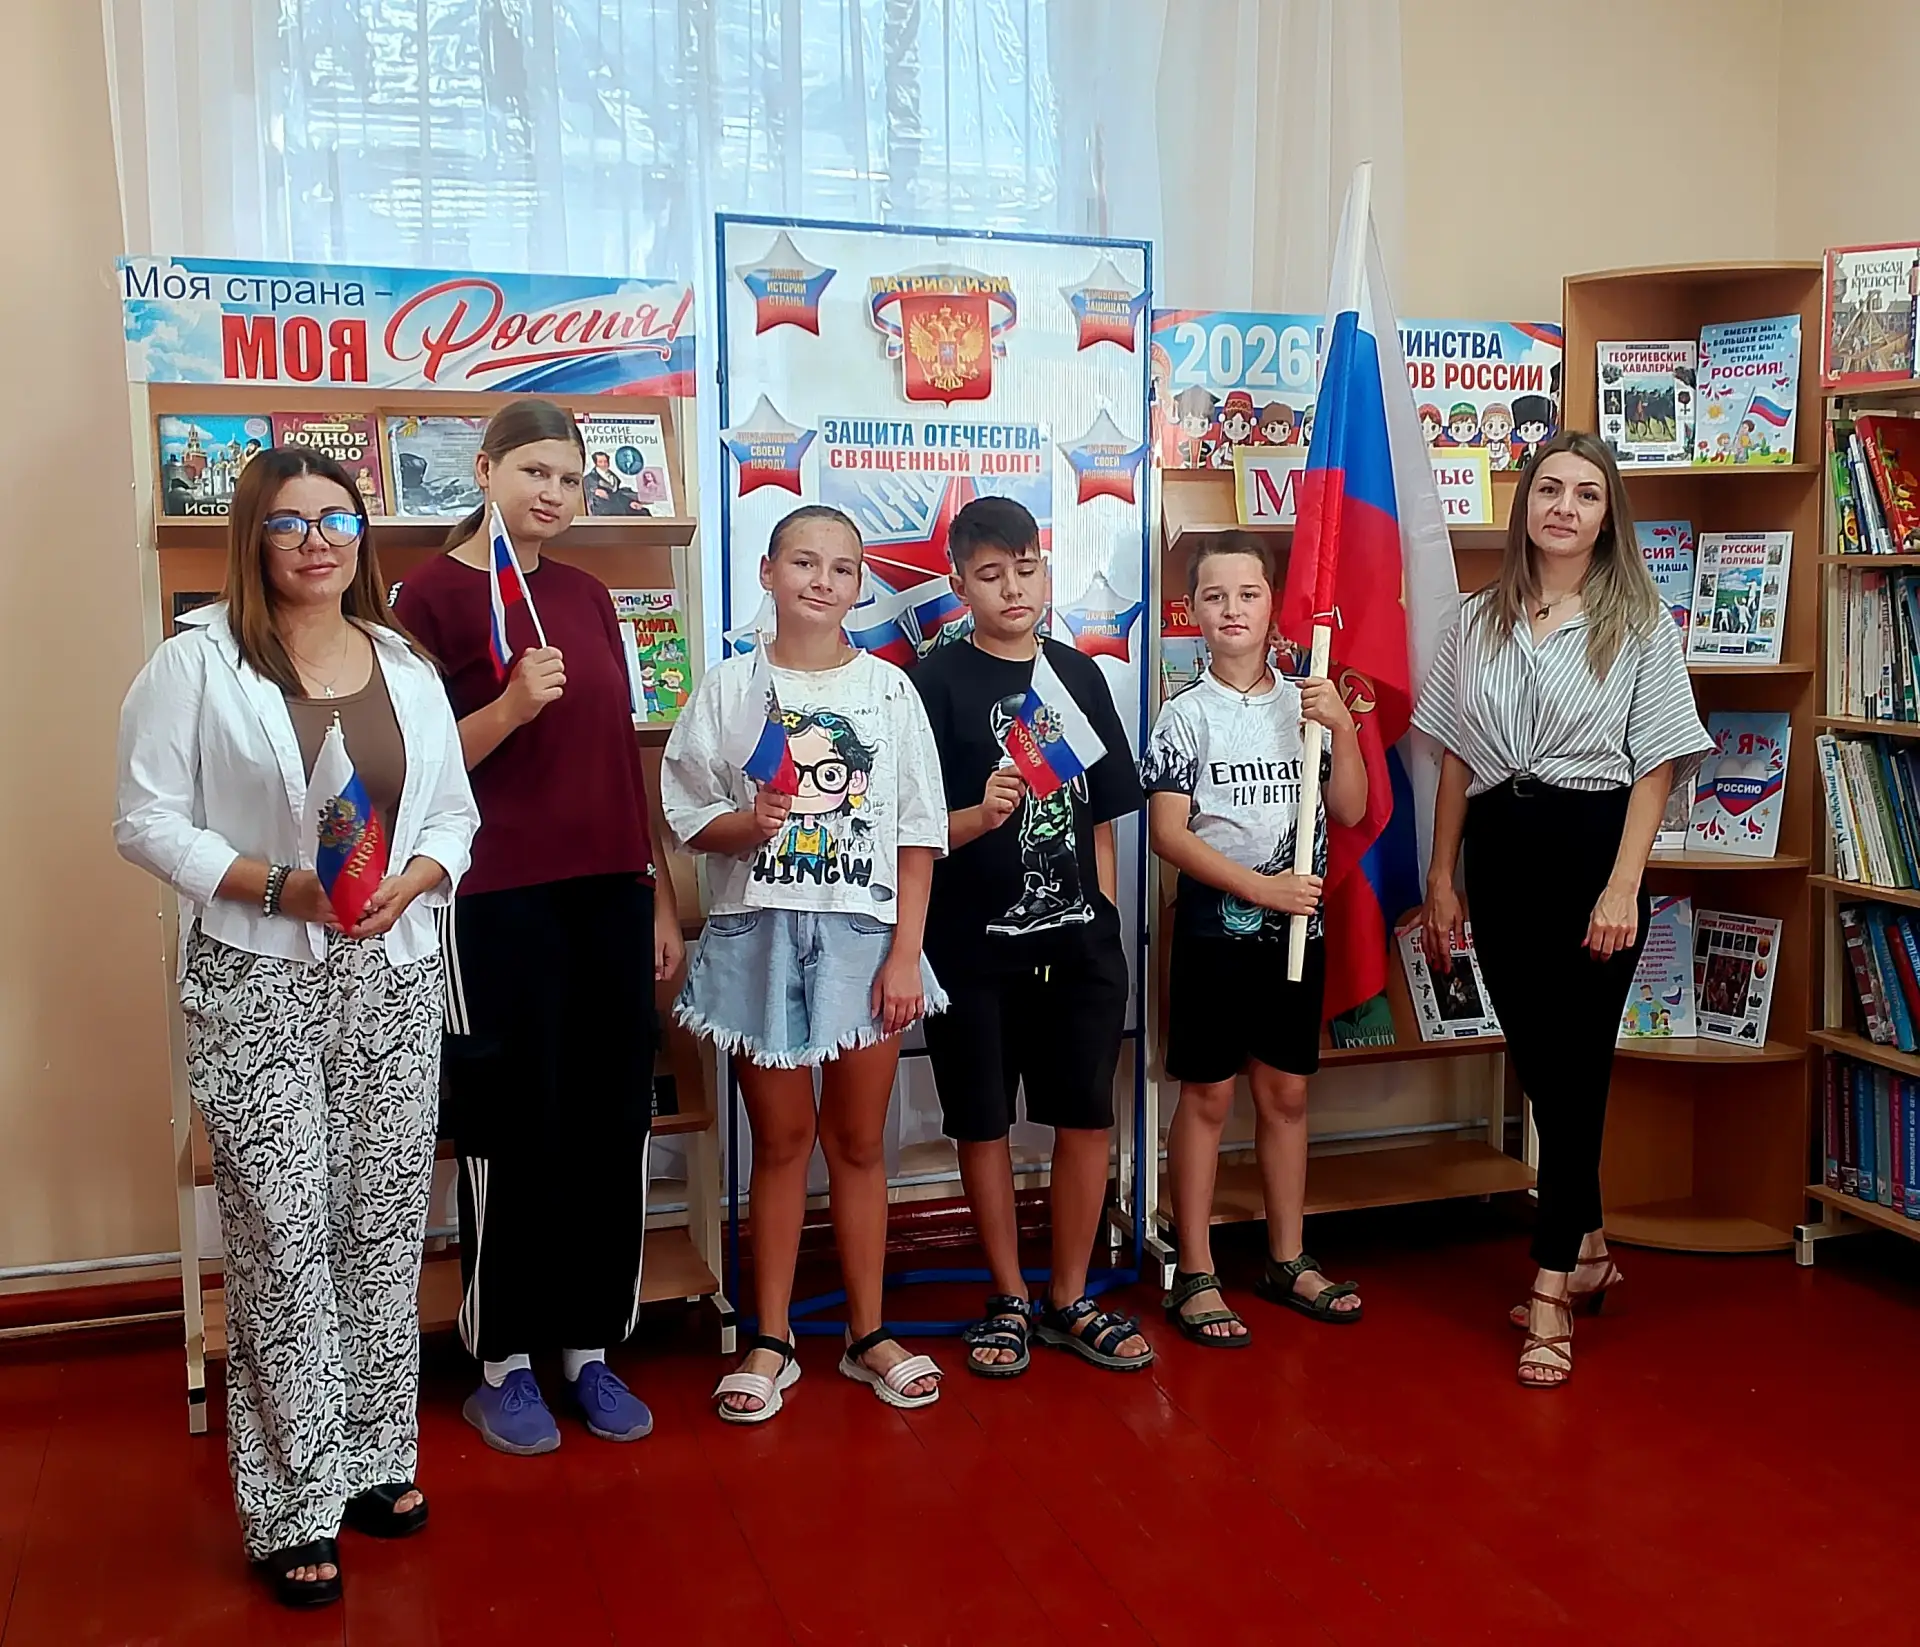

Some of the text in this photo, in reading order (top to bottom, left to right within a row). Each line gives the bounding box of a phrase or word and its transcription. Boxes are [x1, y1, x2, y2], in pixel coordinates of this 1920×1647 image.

[1854, 260, 1903, 278] РУССКАЯ
[125, 265, 210, 300] Моя
[226, 277, 365, 311] страна
[767, 281, 807, 294] ИСТОРИИ
[870, 276, 1011, 293] ПАТРИОТИЗМ
[1851, 275, 1906, 295] КРЕПОСТЬ
[769, 295, 805, 307] СТРАНЫ
[221, 278, 693, 384] МОЯ Россия!
[1174, 322, 1311, 387] 2026
[1398, 330, 1503, 359] ИНСТВА
[1609, 352, 1687, 363] ГЕОРГИЕВСКИЕ
[1730, 354, 1764, 363] СТРАНА
[1622, 363, 1674, 373] КАВАЛЕРЫ
[1711, 361, 1784, 379] РОССИЯ!
[1406, 363, 1543, 391] ОВ РОССИИ
[584, 425, 632, 434] РУССКИЕ
[824, 420, 914, 448] ЗАЩИТА
[283, 431, 368, 448] РОДНОЕ
[586, 435, 658, 444] АРХИТЕКТОРЫ
[750, 445, 786, 457] СВОЕМУ
[751, 458, 786, 470] НАРОДУ
[830, 449, 1041, 475] СВЯЩЕННЫЙ ДОЛГ!
[1251, 469, 1305, 516] М
[1642, 547, 1675, 559] СИЯ
[1721, 544, 1766, 554] РУССКИЕ
[1721, 556, 1765, 565] КОЛУМБЫ
[1656, 563, 1689, 572] НАША
[1171, 612, 1189, 626] РО
[1082, 624, 1120, 635] ПРИРОДЫ
[1737, 733, 1754, 754] Я
[1716, 782, 1762, 794] РОССИЮ
[1233, 784, 1302, 806] FLY BETTE
